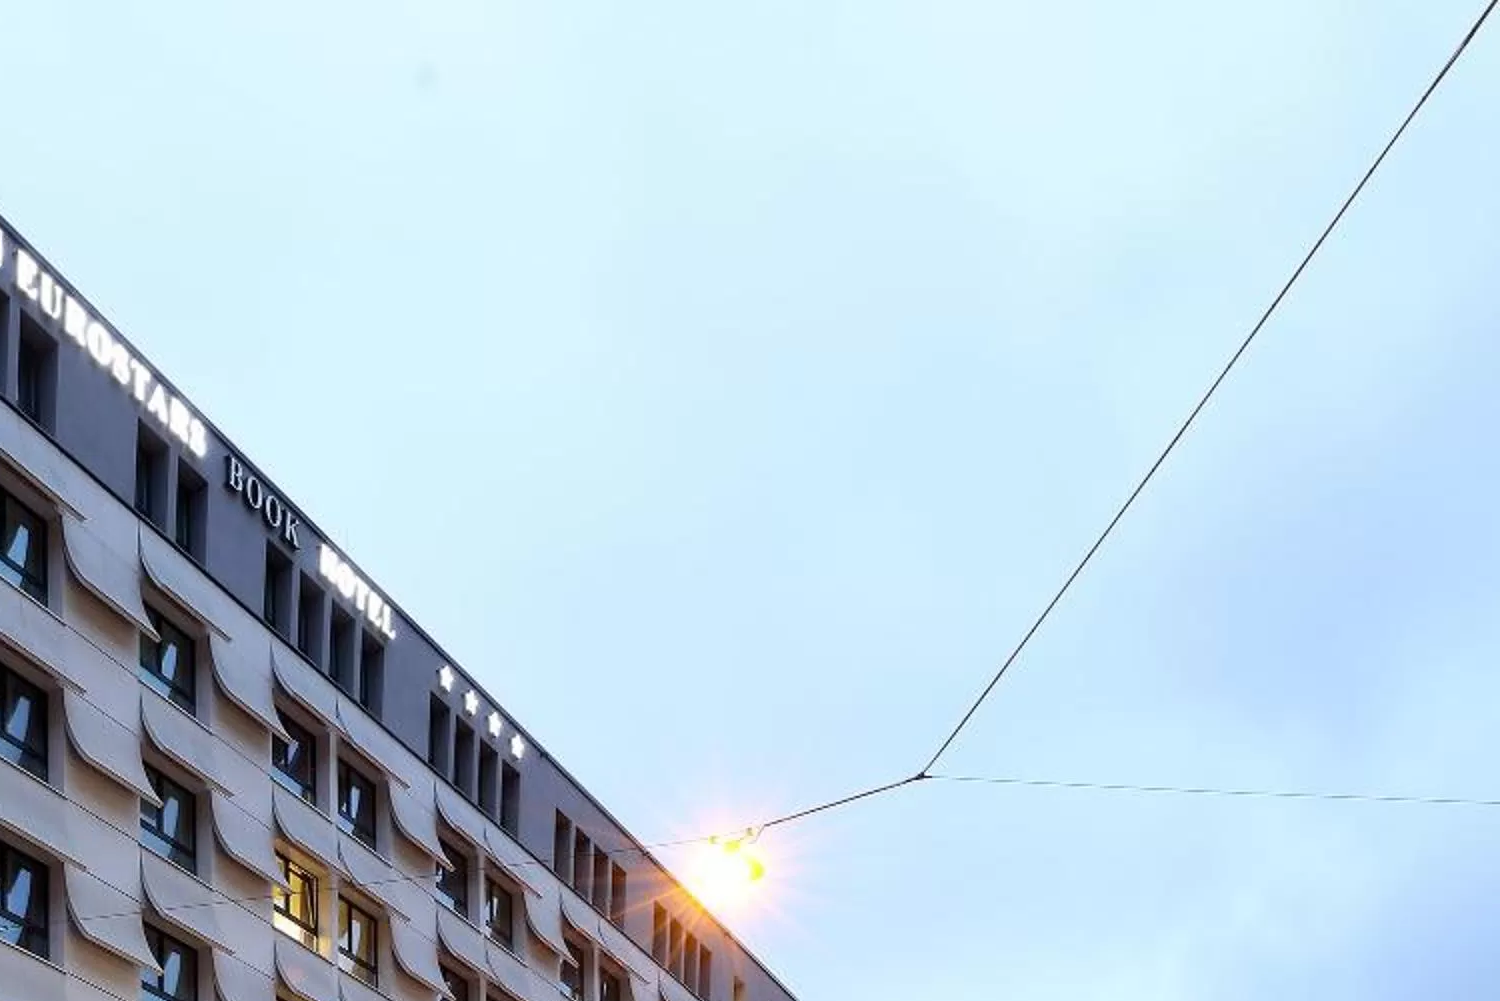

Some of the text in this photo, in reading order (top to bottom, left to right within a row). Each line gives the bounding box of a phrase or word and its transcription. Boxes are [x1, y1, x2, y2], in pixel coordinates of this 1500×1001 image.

[15, 248, 396, 640] EUROSTARS BOOK HOTEL
